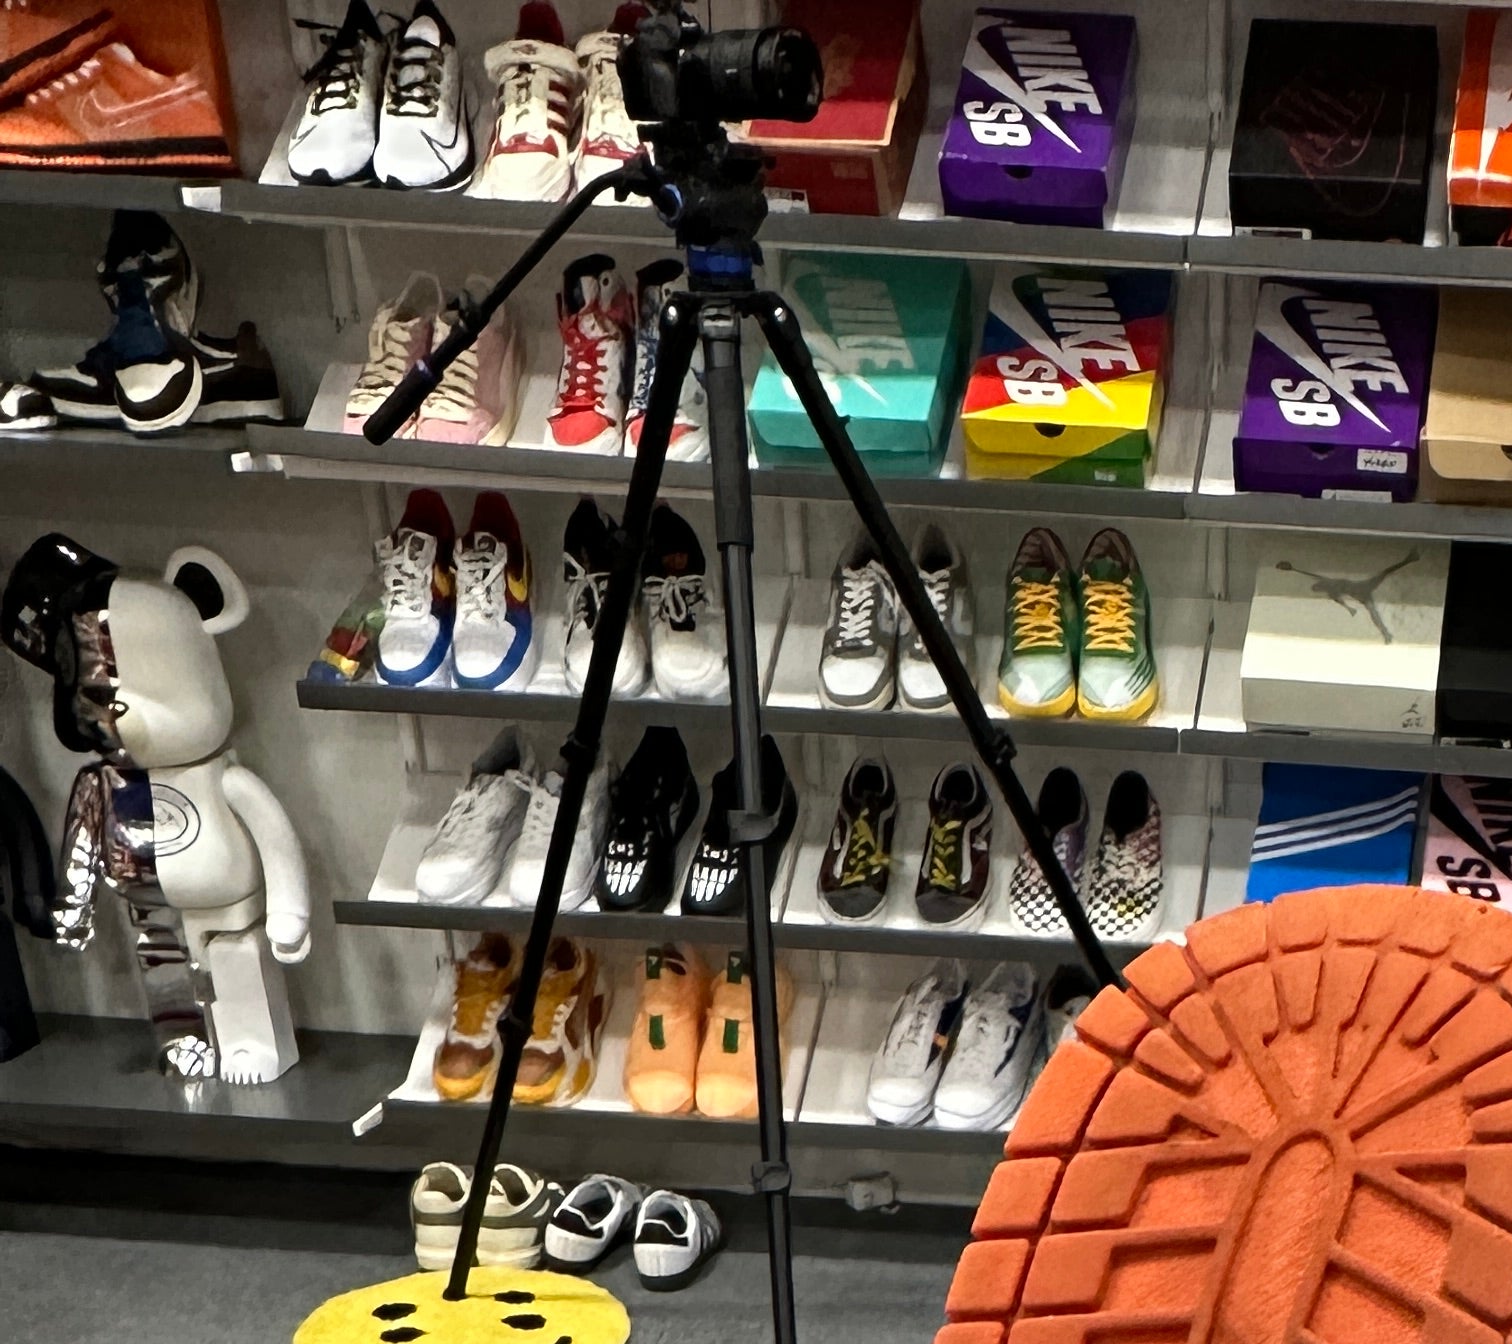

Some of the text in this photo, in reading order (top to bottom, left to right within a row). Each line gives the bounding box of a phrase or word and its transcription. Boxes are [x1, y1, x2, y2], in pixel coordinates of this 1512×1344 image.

[1002, 27, 1103, 115] NIKE
[963, 101, 1032, 146] SB
[821, 276, 916, 374] NIKE
[1036, 277, 1142, 372] NIKE
[1302, 299, 1410, 394] NIKE
[997, 355, 1069, 407] SB
[1270, 378, 1341, 427] SB
[1436, 855, 1501, 902] SB
